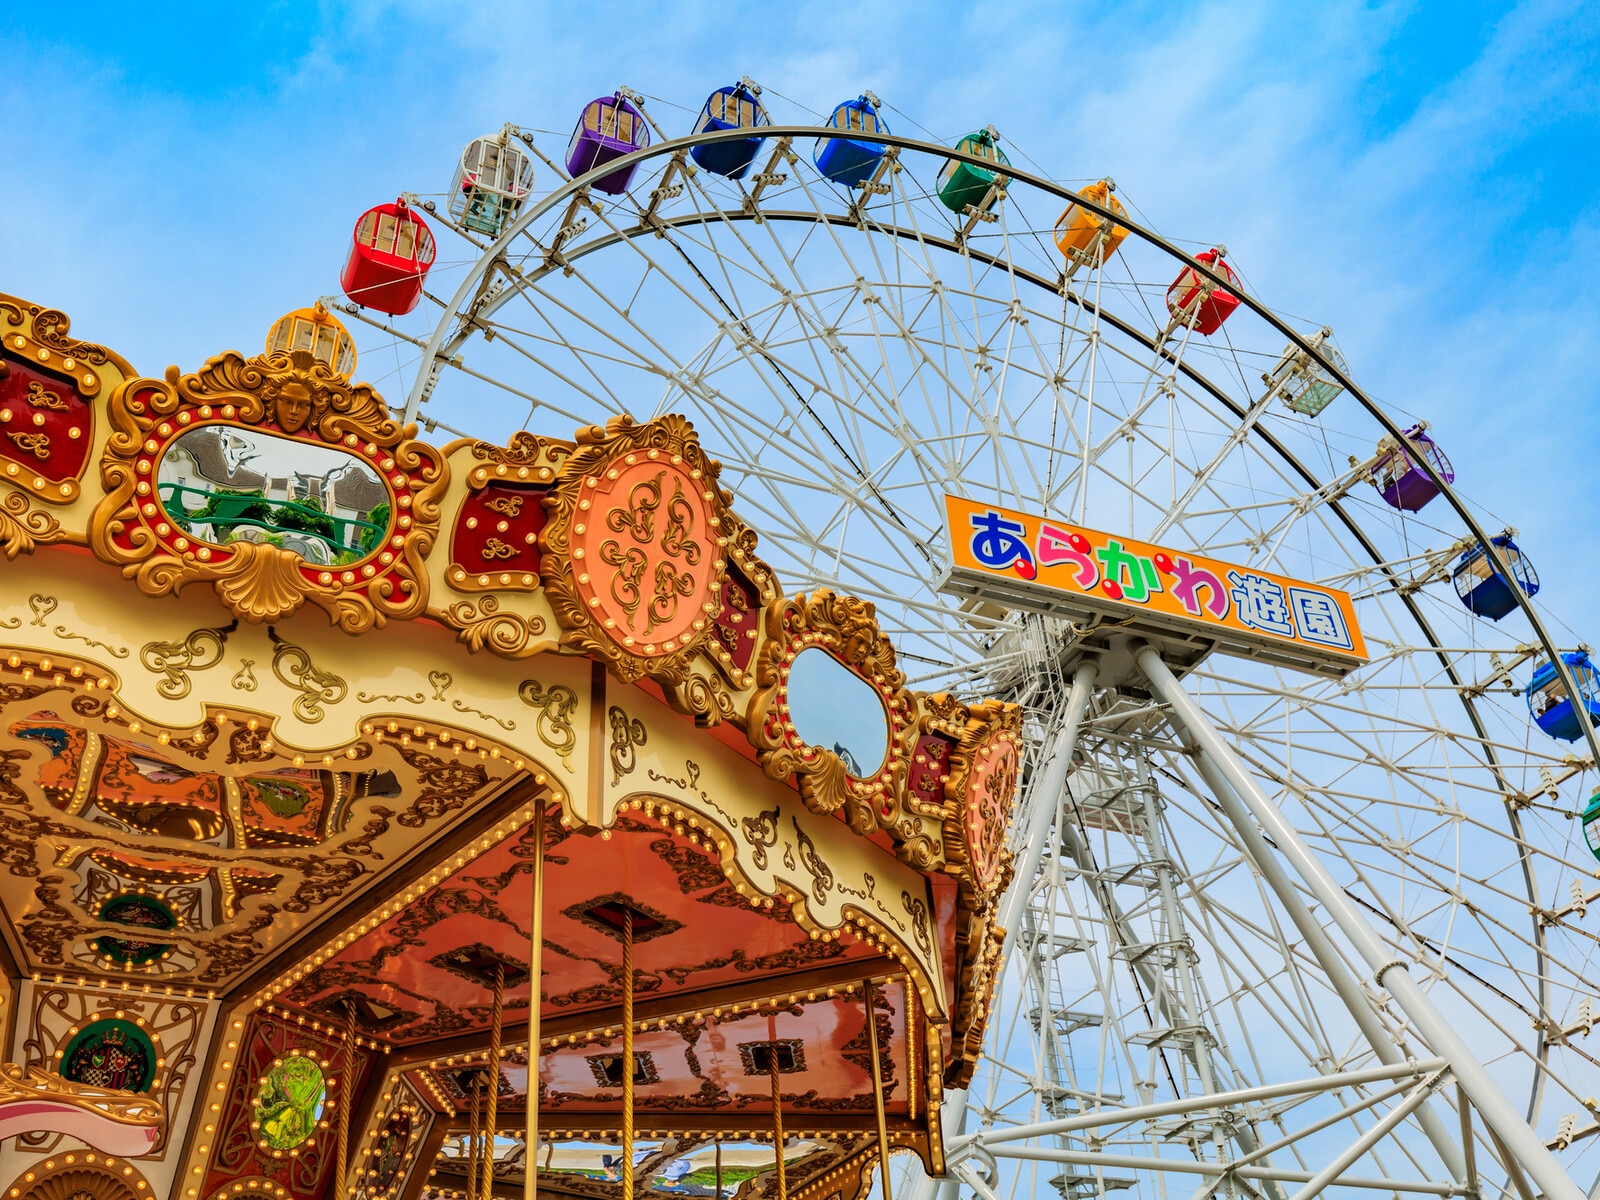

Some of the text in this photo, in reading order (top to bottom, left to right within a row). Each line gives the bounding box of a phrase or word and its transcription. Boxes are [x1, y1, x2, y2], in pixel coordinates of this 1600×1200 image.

[969, 509, 1354, 650] あらかわ遊園
